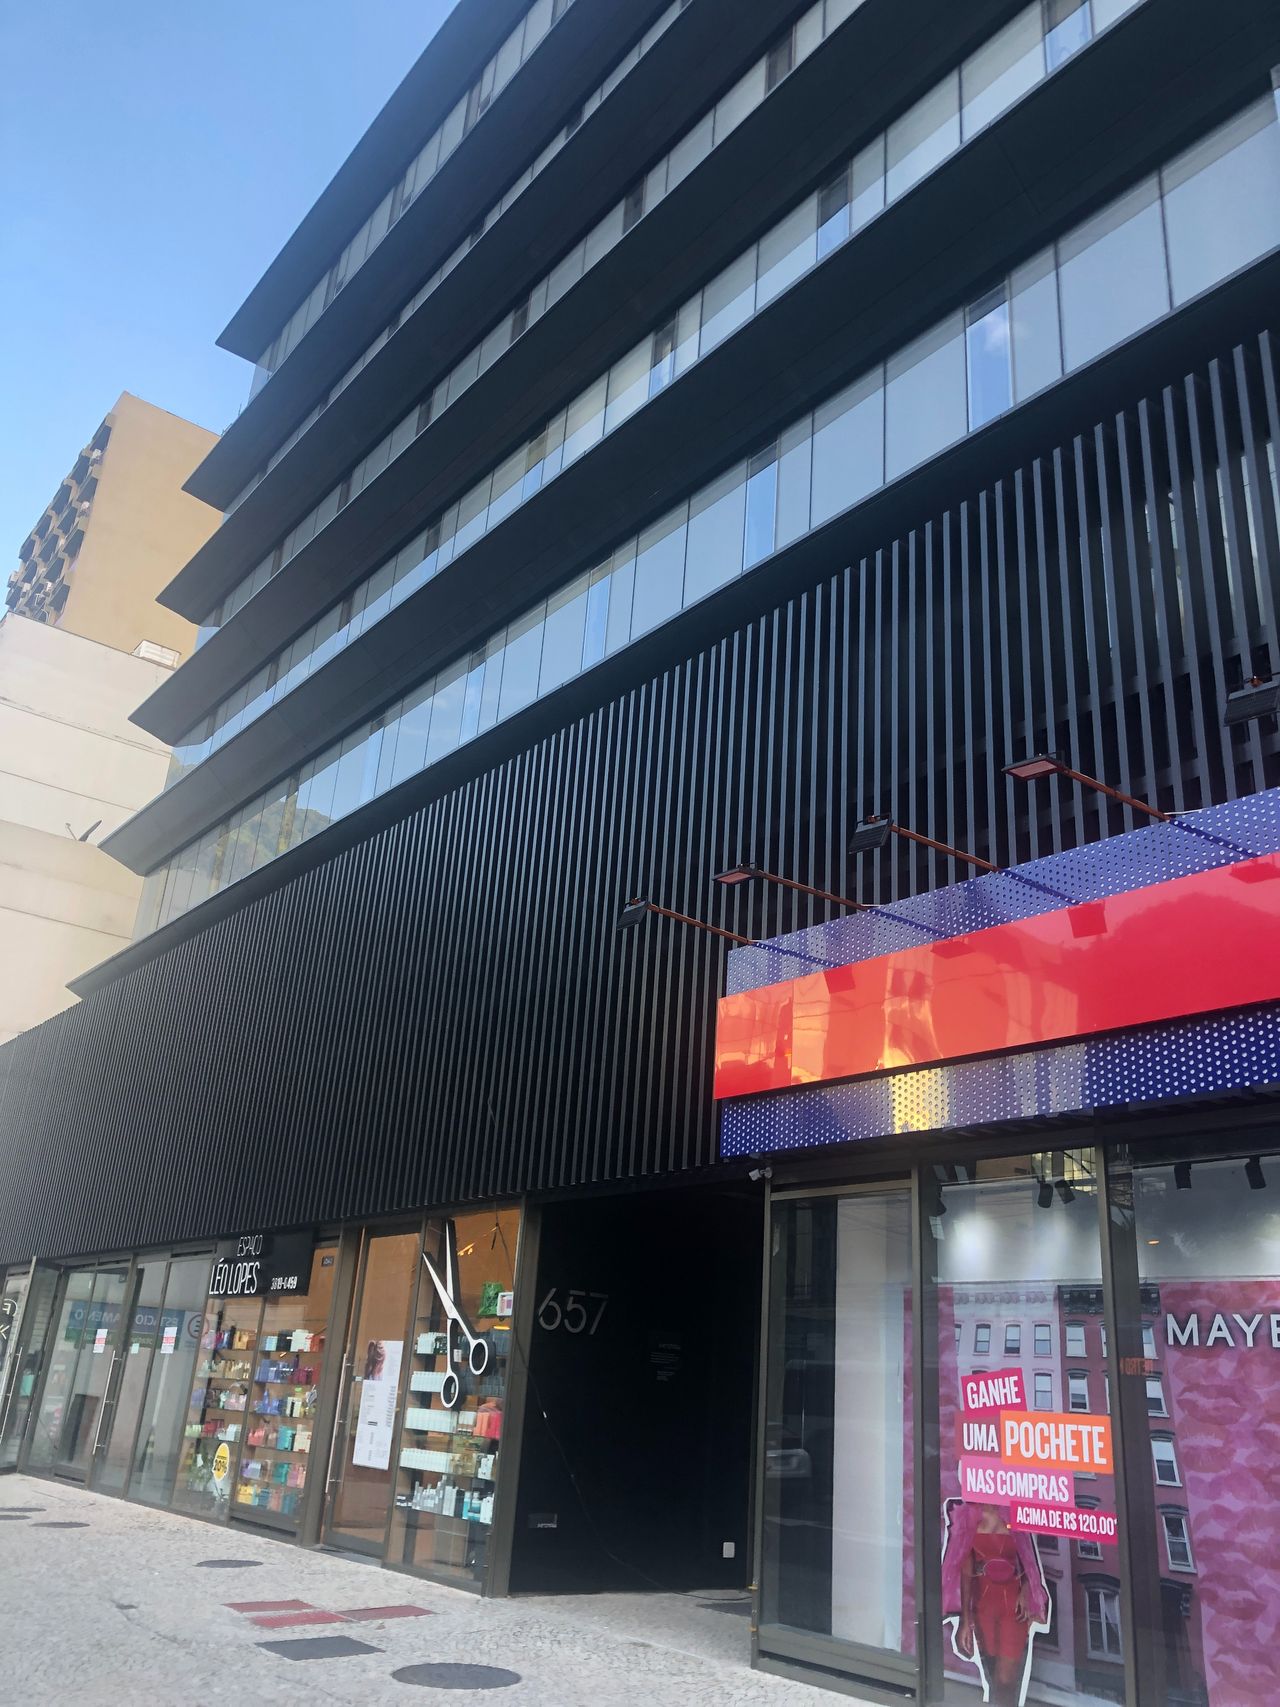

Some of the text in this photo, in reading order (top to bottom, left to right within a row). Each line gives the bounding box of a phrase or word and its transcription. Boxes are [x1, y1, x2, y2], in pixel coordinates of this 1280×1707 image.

[208, 1257, 260, 1294] LÉO LOPES
[538, 1287, 609, 1335] 657
[966, 1375, 1021, 1409] GANHE
[963, 1420, 1107, 1465] UMA POCHETE
[966, 1467, 1070, 1502] NAS COMPRAS
[1016, 1506, 1048, 1527] ACIMA
[1048, 1510, 1063, 1529] DE
[1063, 1511, 1078, 1531] R$
